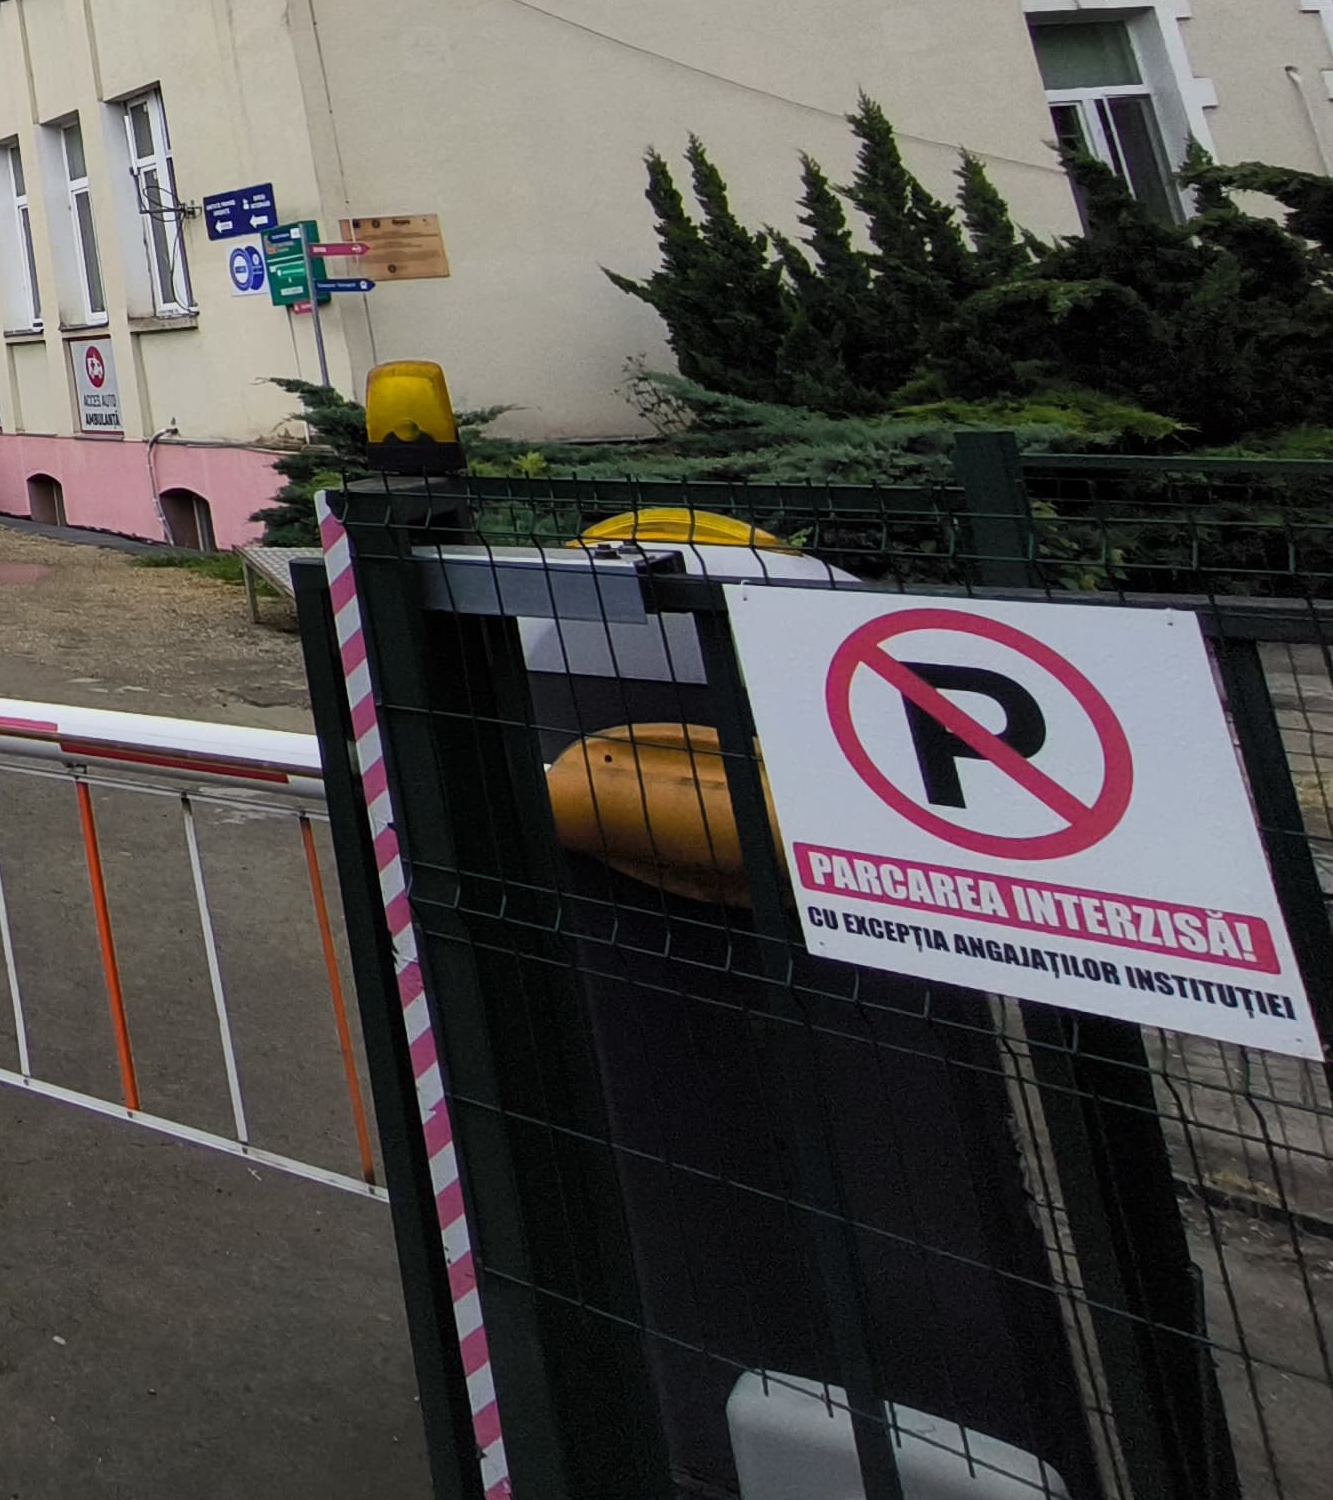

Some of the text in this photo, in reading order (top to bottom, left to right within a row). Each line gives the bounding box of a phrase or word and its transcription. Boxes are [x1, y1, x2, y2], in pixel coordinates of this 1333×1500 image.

[83, 394, 117, 408] ACCES AUTO
[896, 660, 1047, 809] P
[807, 851, 1257, 962] PARCAREA INTERZISĂ!
[807, 906, 1297, 1020] CU EXCEPȚIA ANGAJAȚILOR INSTITUȚIEI
